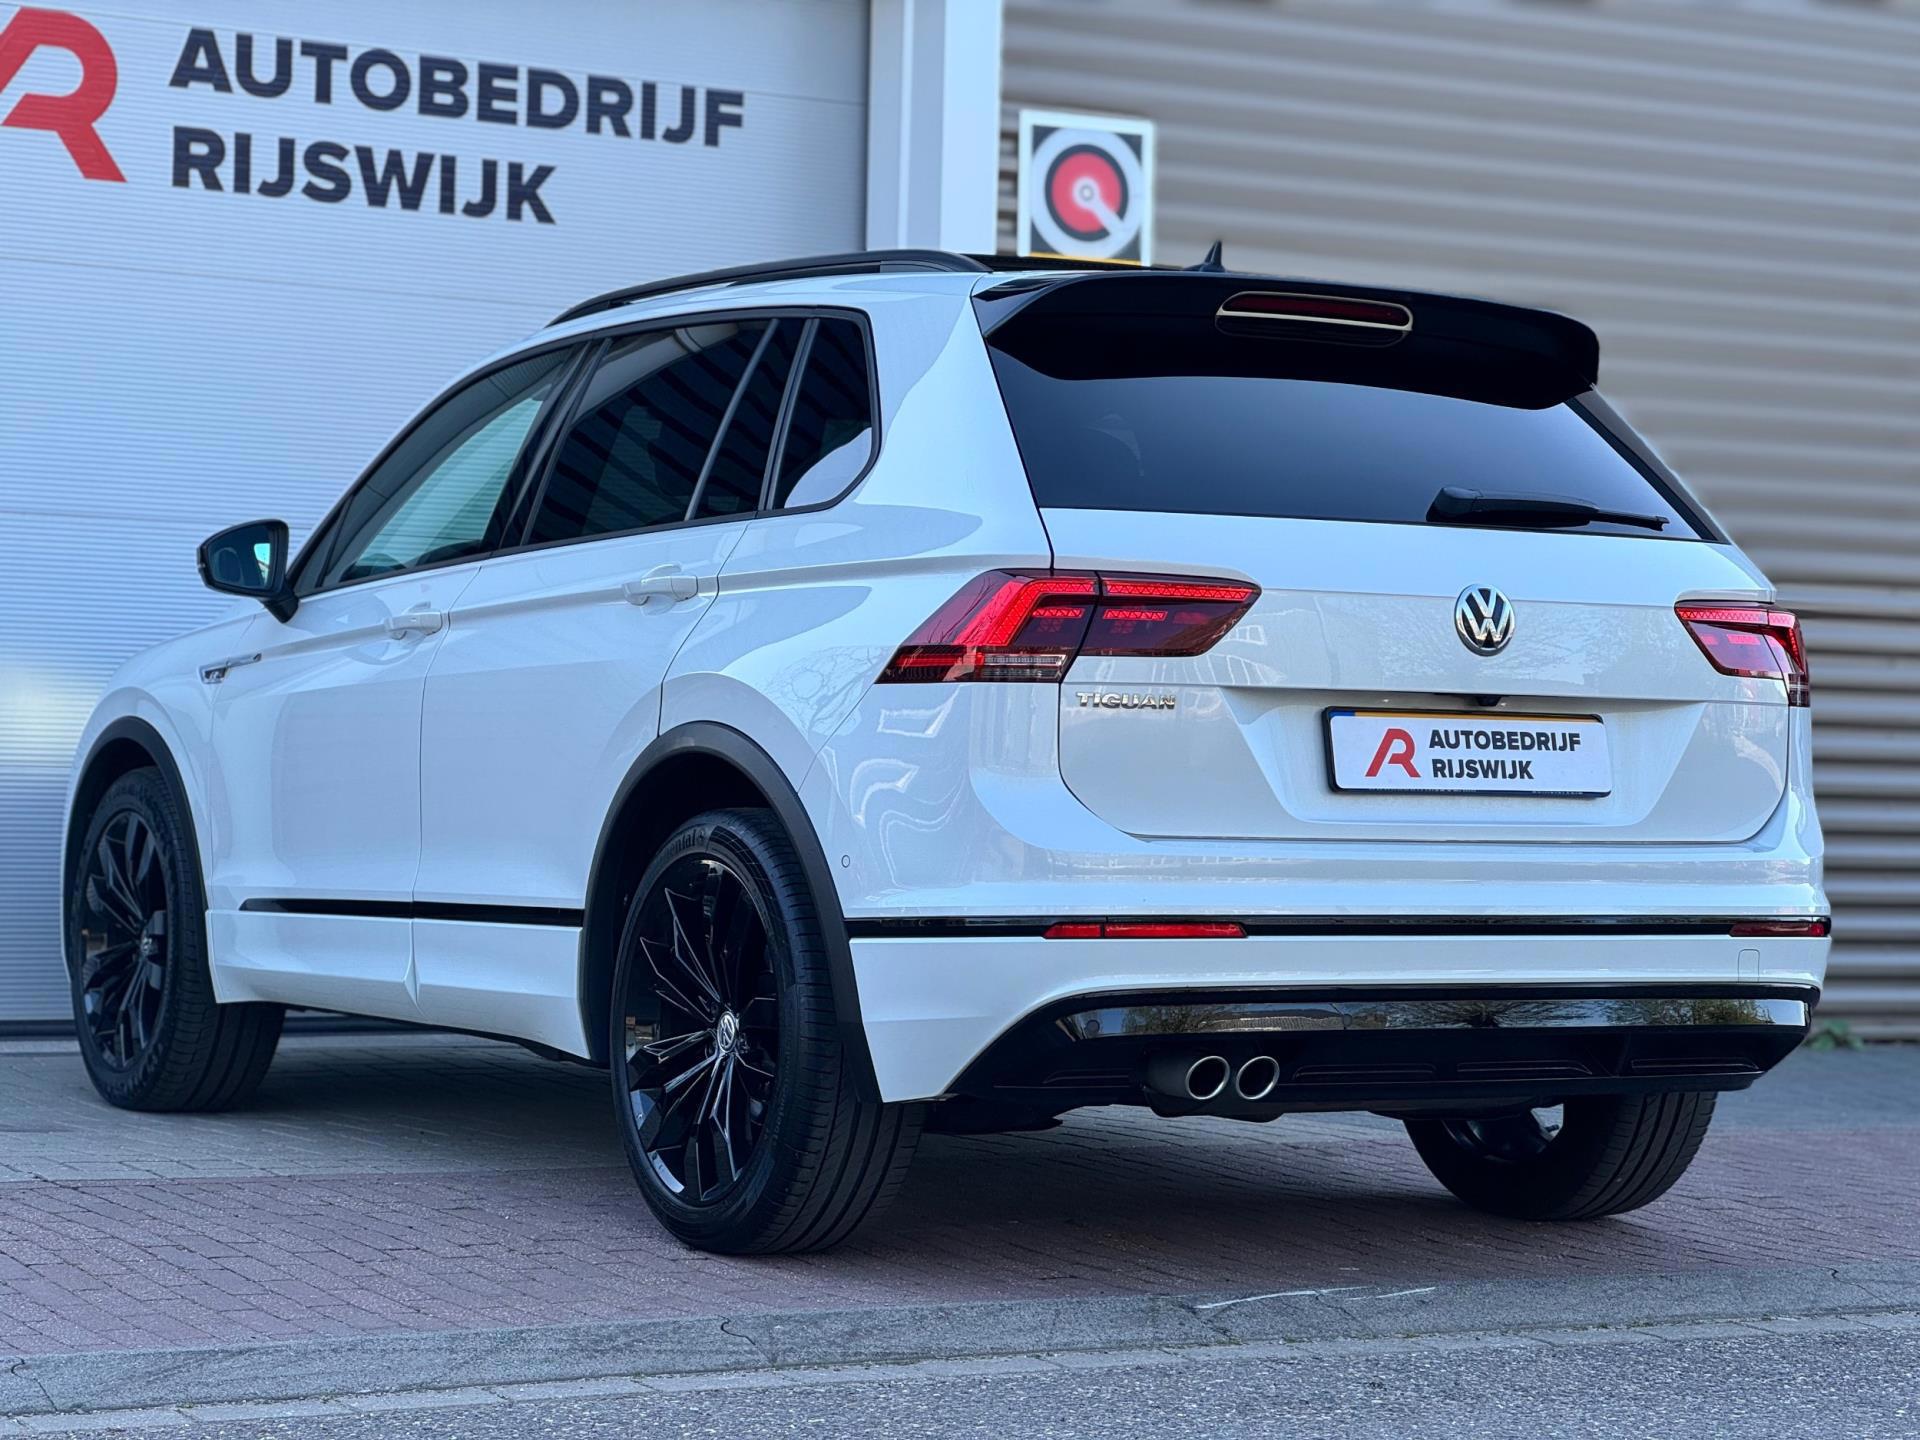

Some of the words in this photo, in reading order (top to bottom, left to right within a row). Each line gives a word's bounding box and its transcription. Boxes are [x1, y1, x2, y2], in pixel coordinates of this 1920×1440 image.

[168, 27, 745, 148] AUTOBEDRIJF
[172, 125, 557, 225] RIJSWIJK
[1076, 691, 1176, 710] TIGUAN
[1429, 729, 1581, 751] AUTOBEDRIJF
[1431, 758, 1535, 780] RIJSWIJK
